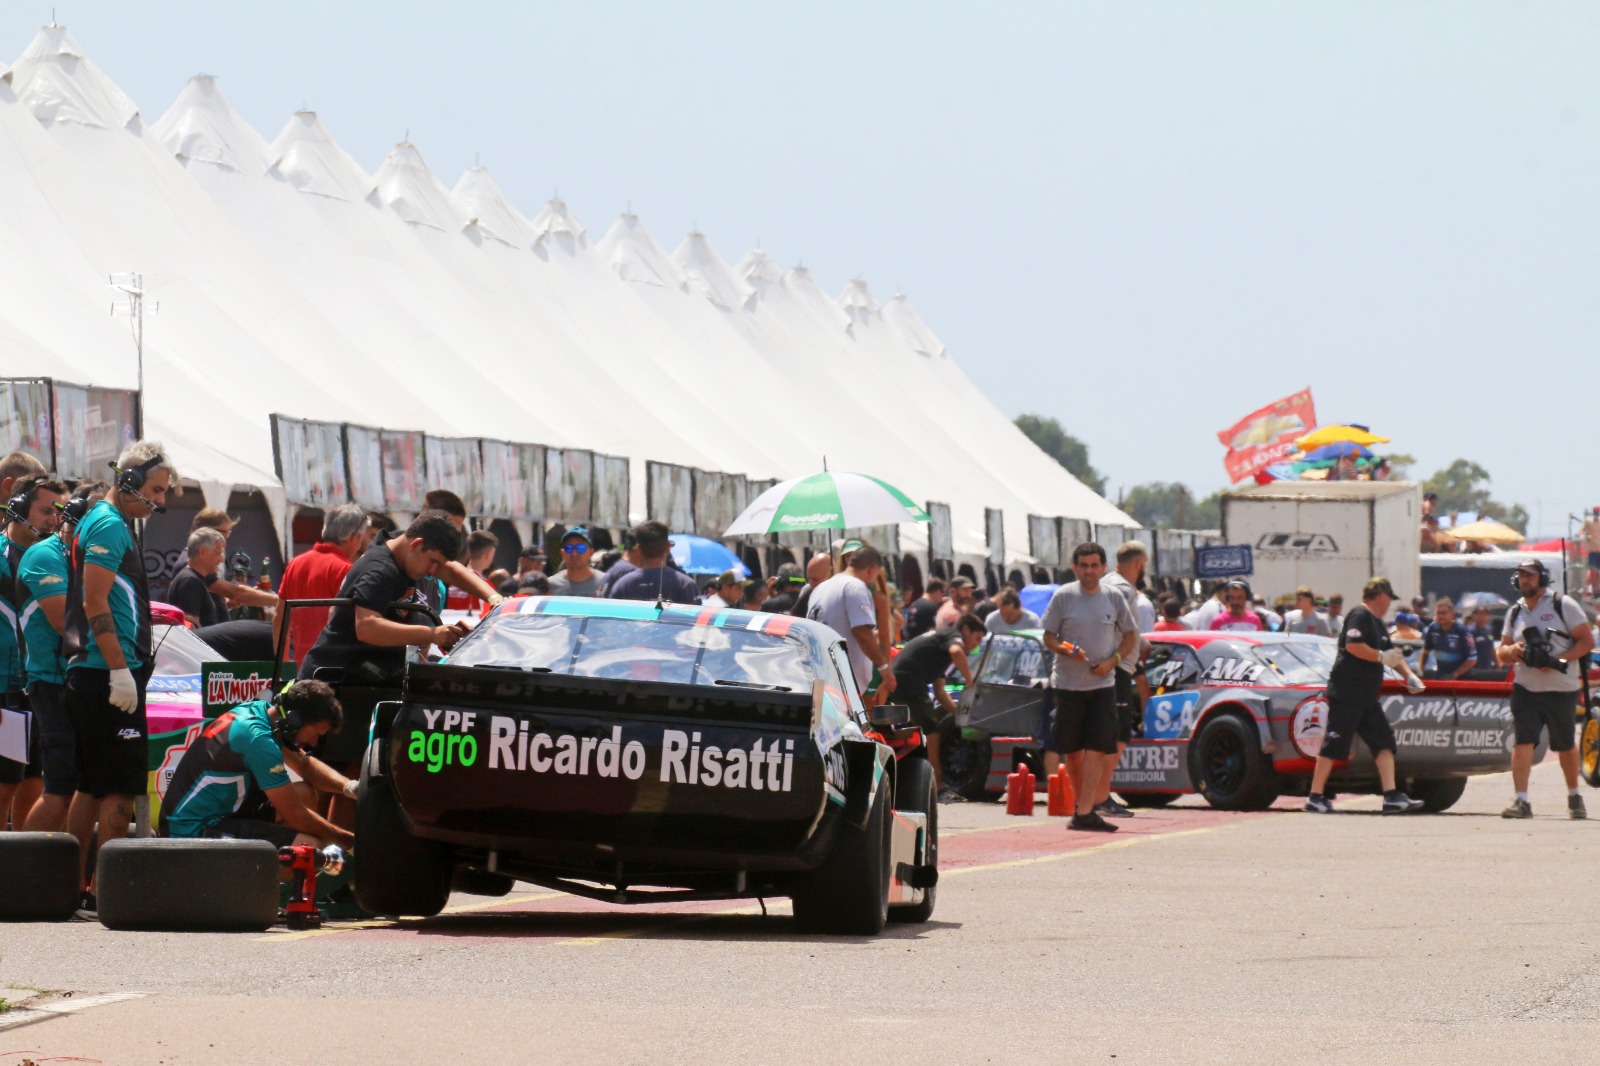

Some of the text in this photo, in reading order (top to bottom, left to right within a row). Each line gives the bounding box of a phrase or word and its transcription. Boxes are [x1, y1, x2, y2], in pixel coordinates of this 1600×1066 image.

[209, 672, 233, 680] Azúcar
[1201, 657, 1266, 681] AMA
[208, 679, 229, 704] LA
[423, 709, 476, 733] YPF
[1453, 730, 1504, 747] COMEX
[408, 730, 477, 773] agro
[489, 716, 646, 780] Ricardo
[660, 729, 795, 792] Risatti
